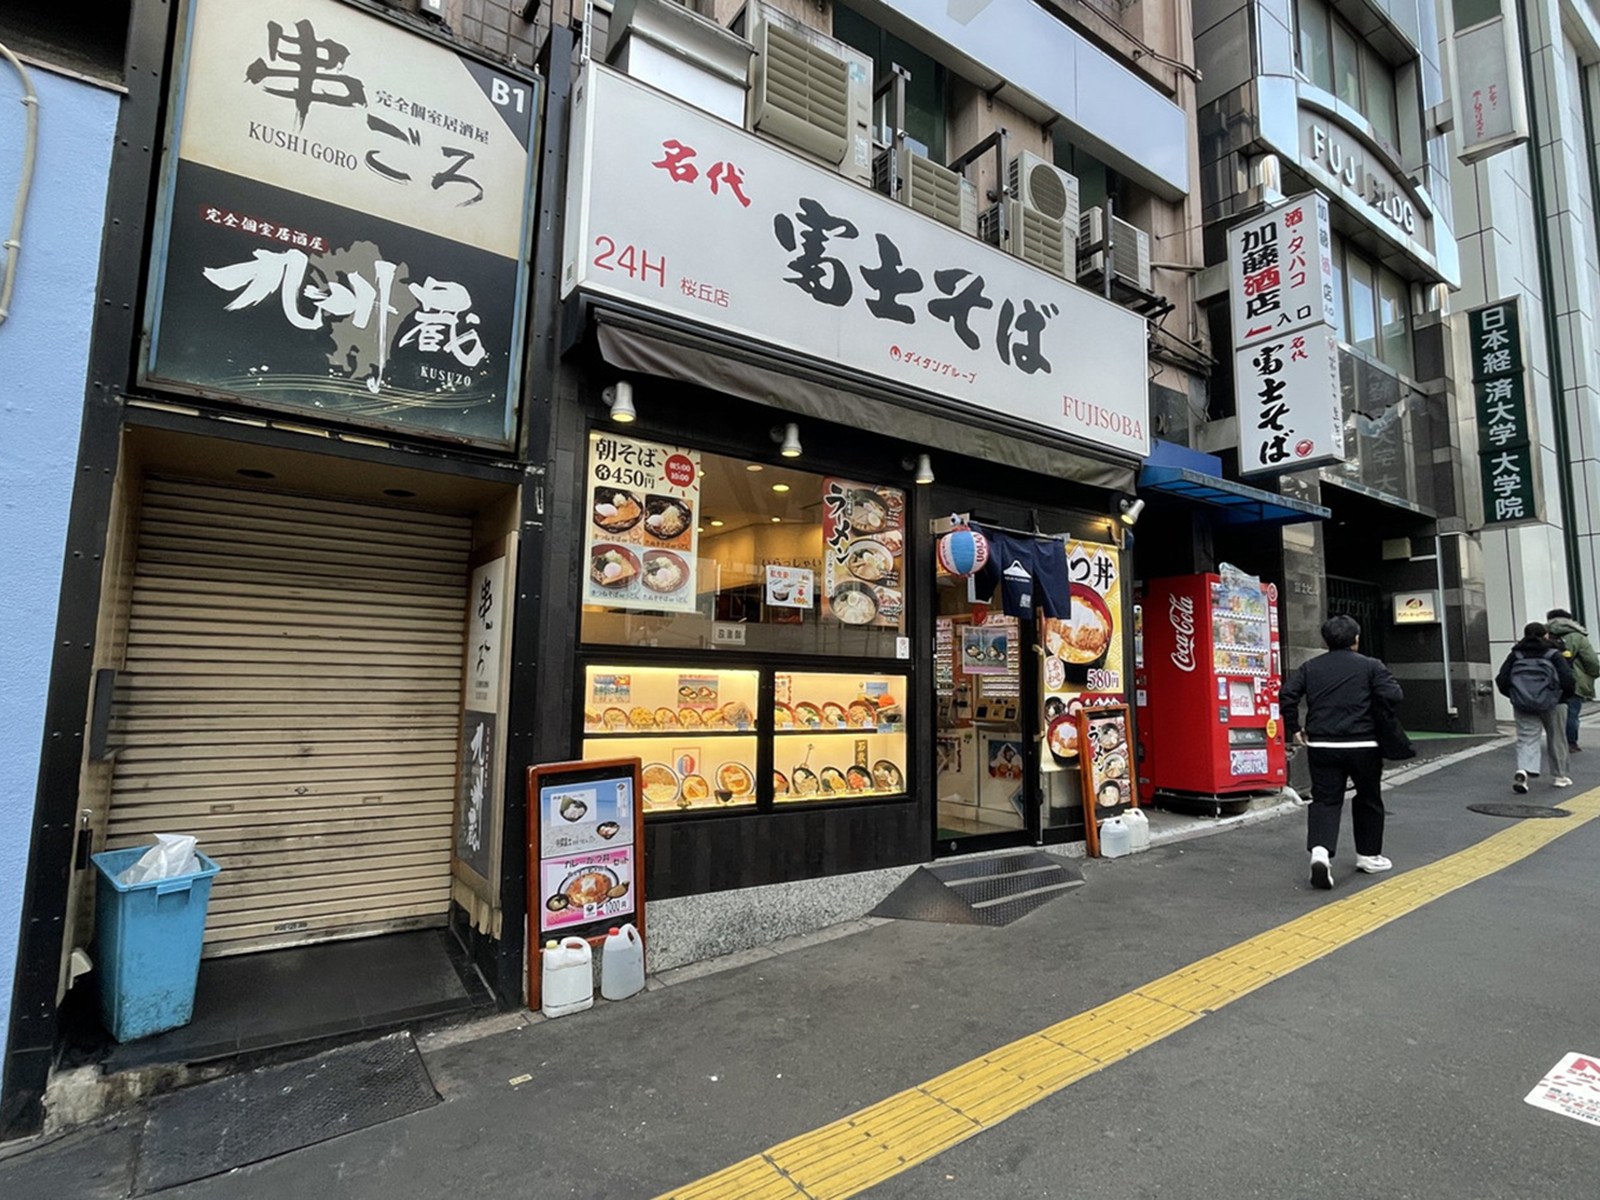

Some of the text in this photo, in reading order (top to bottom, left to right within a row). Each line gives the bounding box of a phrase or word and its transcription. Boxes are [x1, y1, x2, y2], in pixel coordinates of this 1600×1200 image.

[376, 90, 490, 146] 完全個室居酒屋
[491, 77, 526, 114] B1
[248, 121, 358, 171] KUSHIGORO
[652, 139, 752, 208] 名代
[206, 207, 326, 252] 完全個室居酒屋
[1284, 207, 1307, 289] 酒・タバコ
[593, 235, 666, 288] 24H
[773, 197, 1060, 375] 富士そば
[1240, 221, 1282, 320] 加藤酒店
[680, 276, 730, 308] 桜丘店
[1277, 304, 1312, 327] 入口
[1289, 336, 1309, 362] 名代
[1062, 395, 1144, 440] FUJISOBA
[1252, 342, 1295, 465] 富士そば
[596, 439, 658, 468] 朝そば
[825, 483, 851, 565] ラーメン
[1086, 668, 1120, 689] 580円
